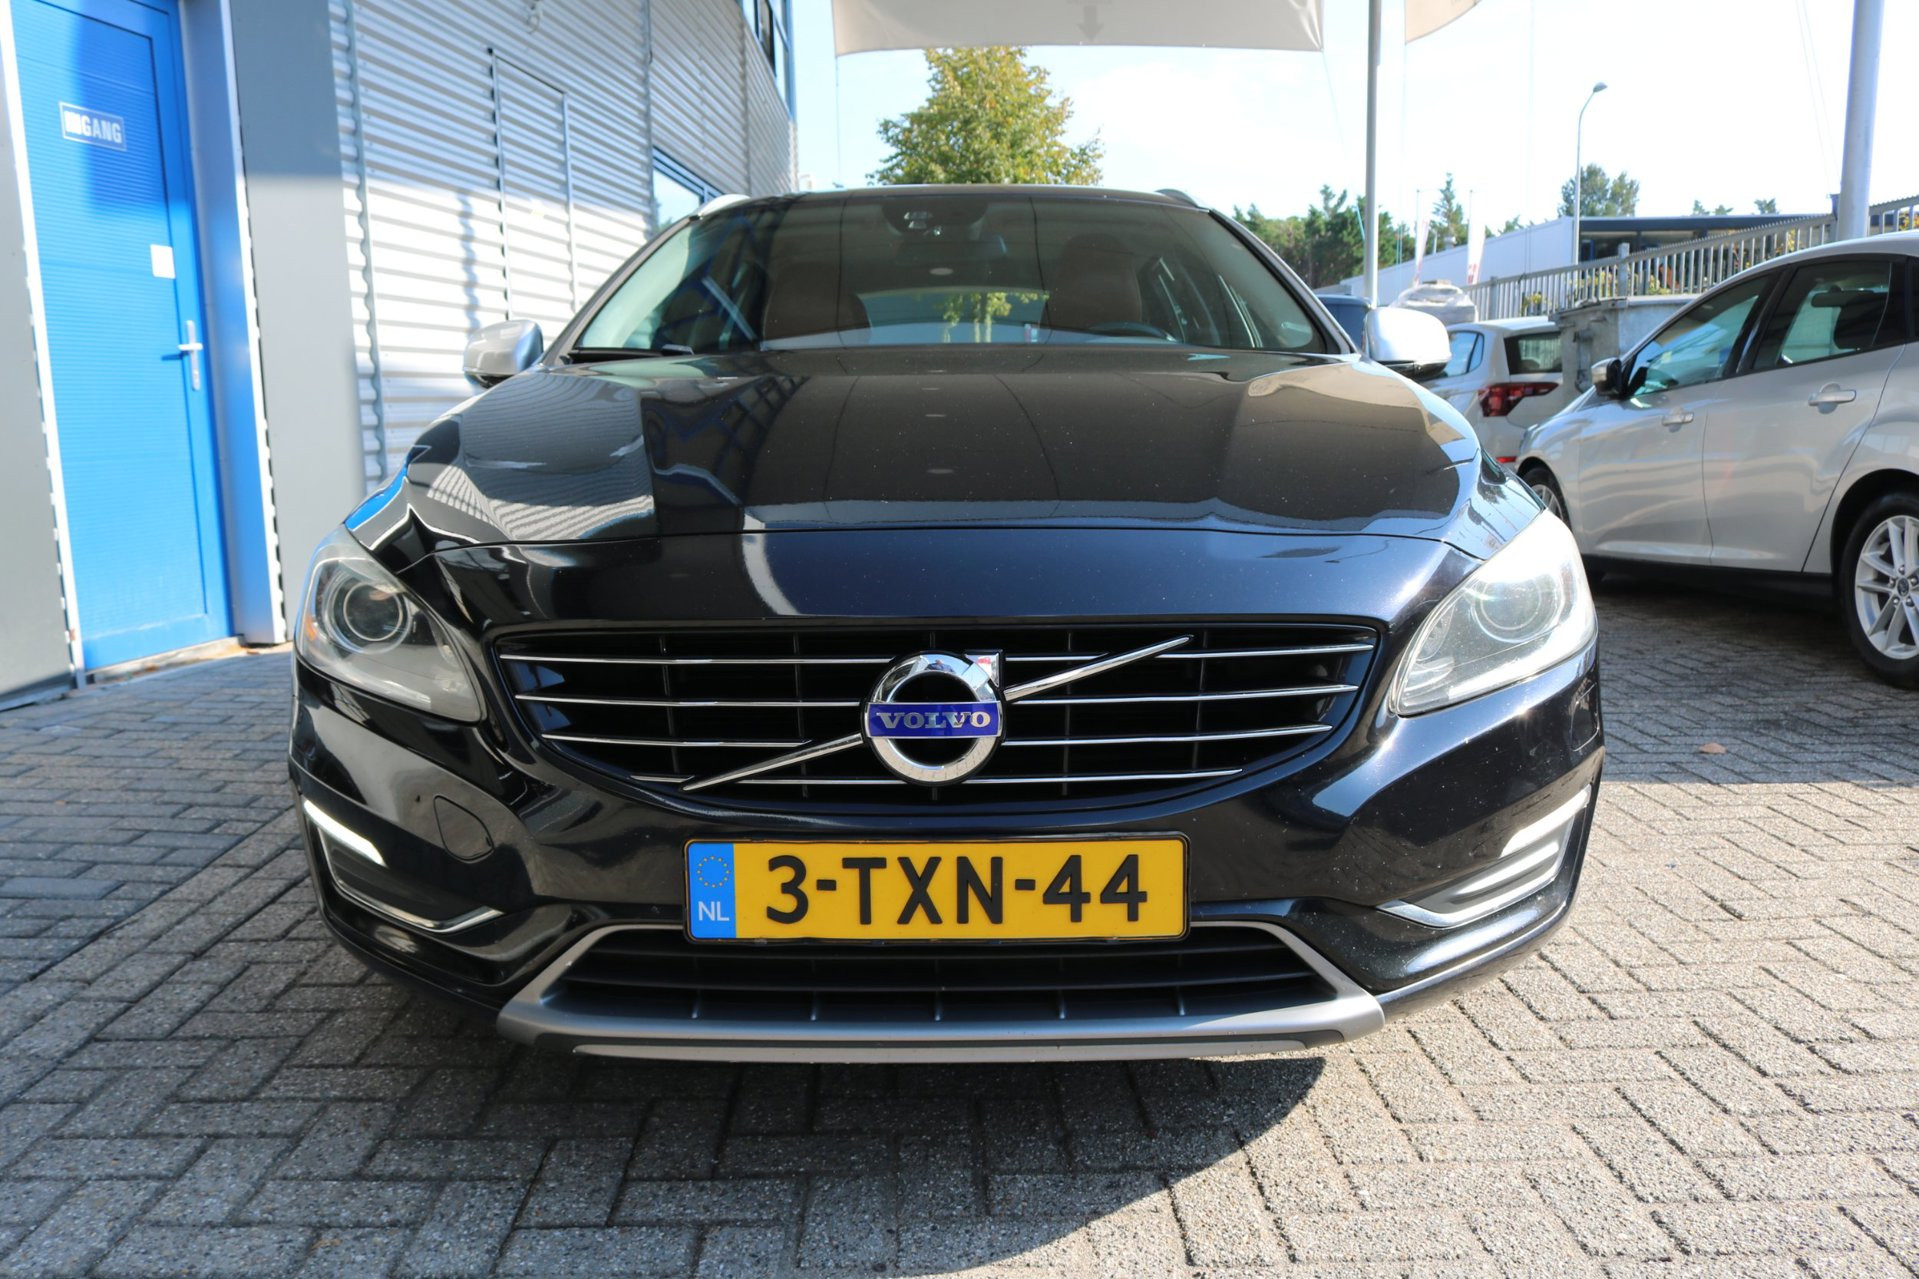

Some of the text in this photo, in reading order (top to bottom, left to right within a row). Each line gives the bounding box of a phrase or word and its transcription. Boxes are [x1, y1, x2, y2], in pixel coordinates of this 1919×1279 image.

[876, 711, 991, 729] VOLVO
[765, 854, 1148, 925] 3-TXN-44
[698, 901, 730, 921] NL
